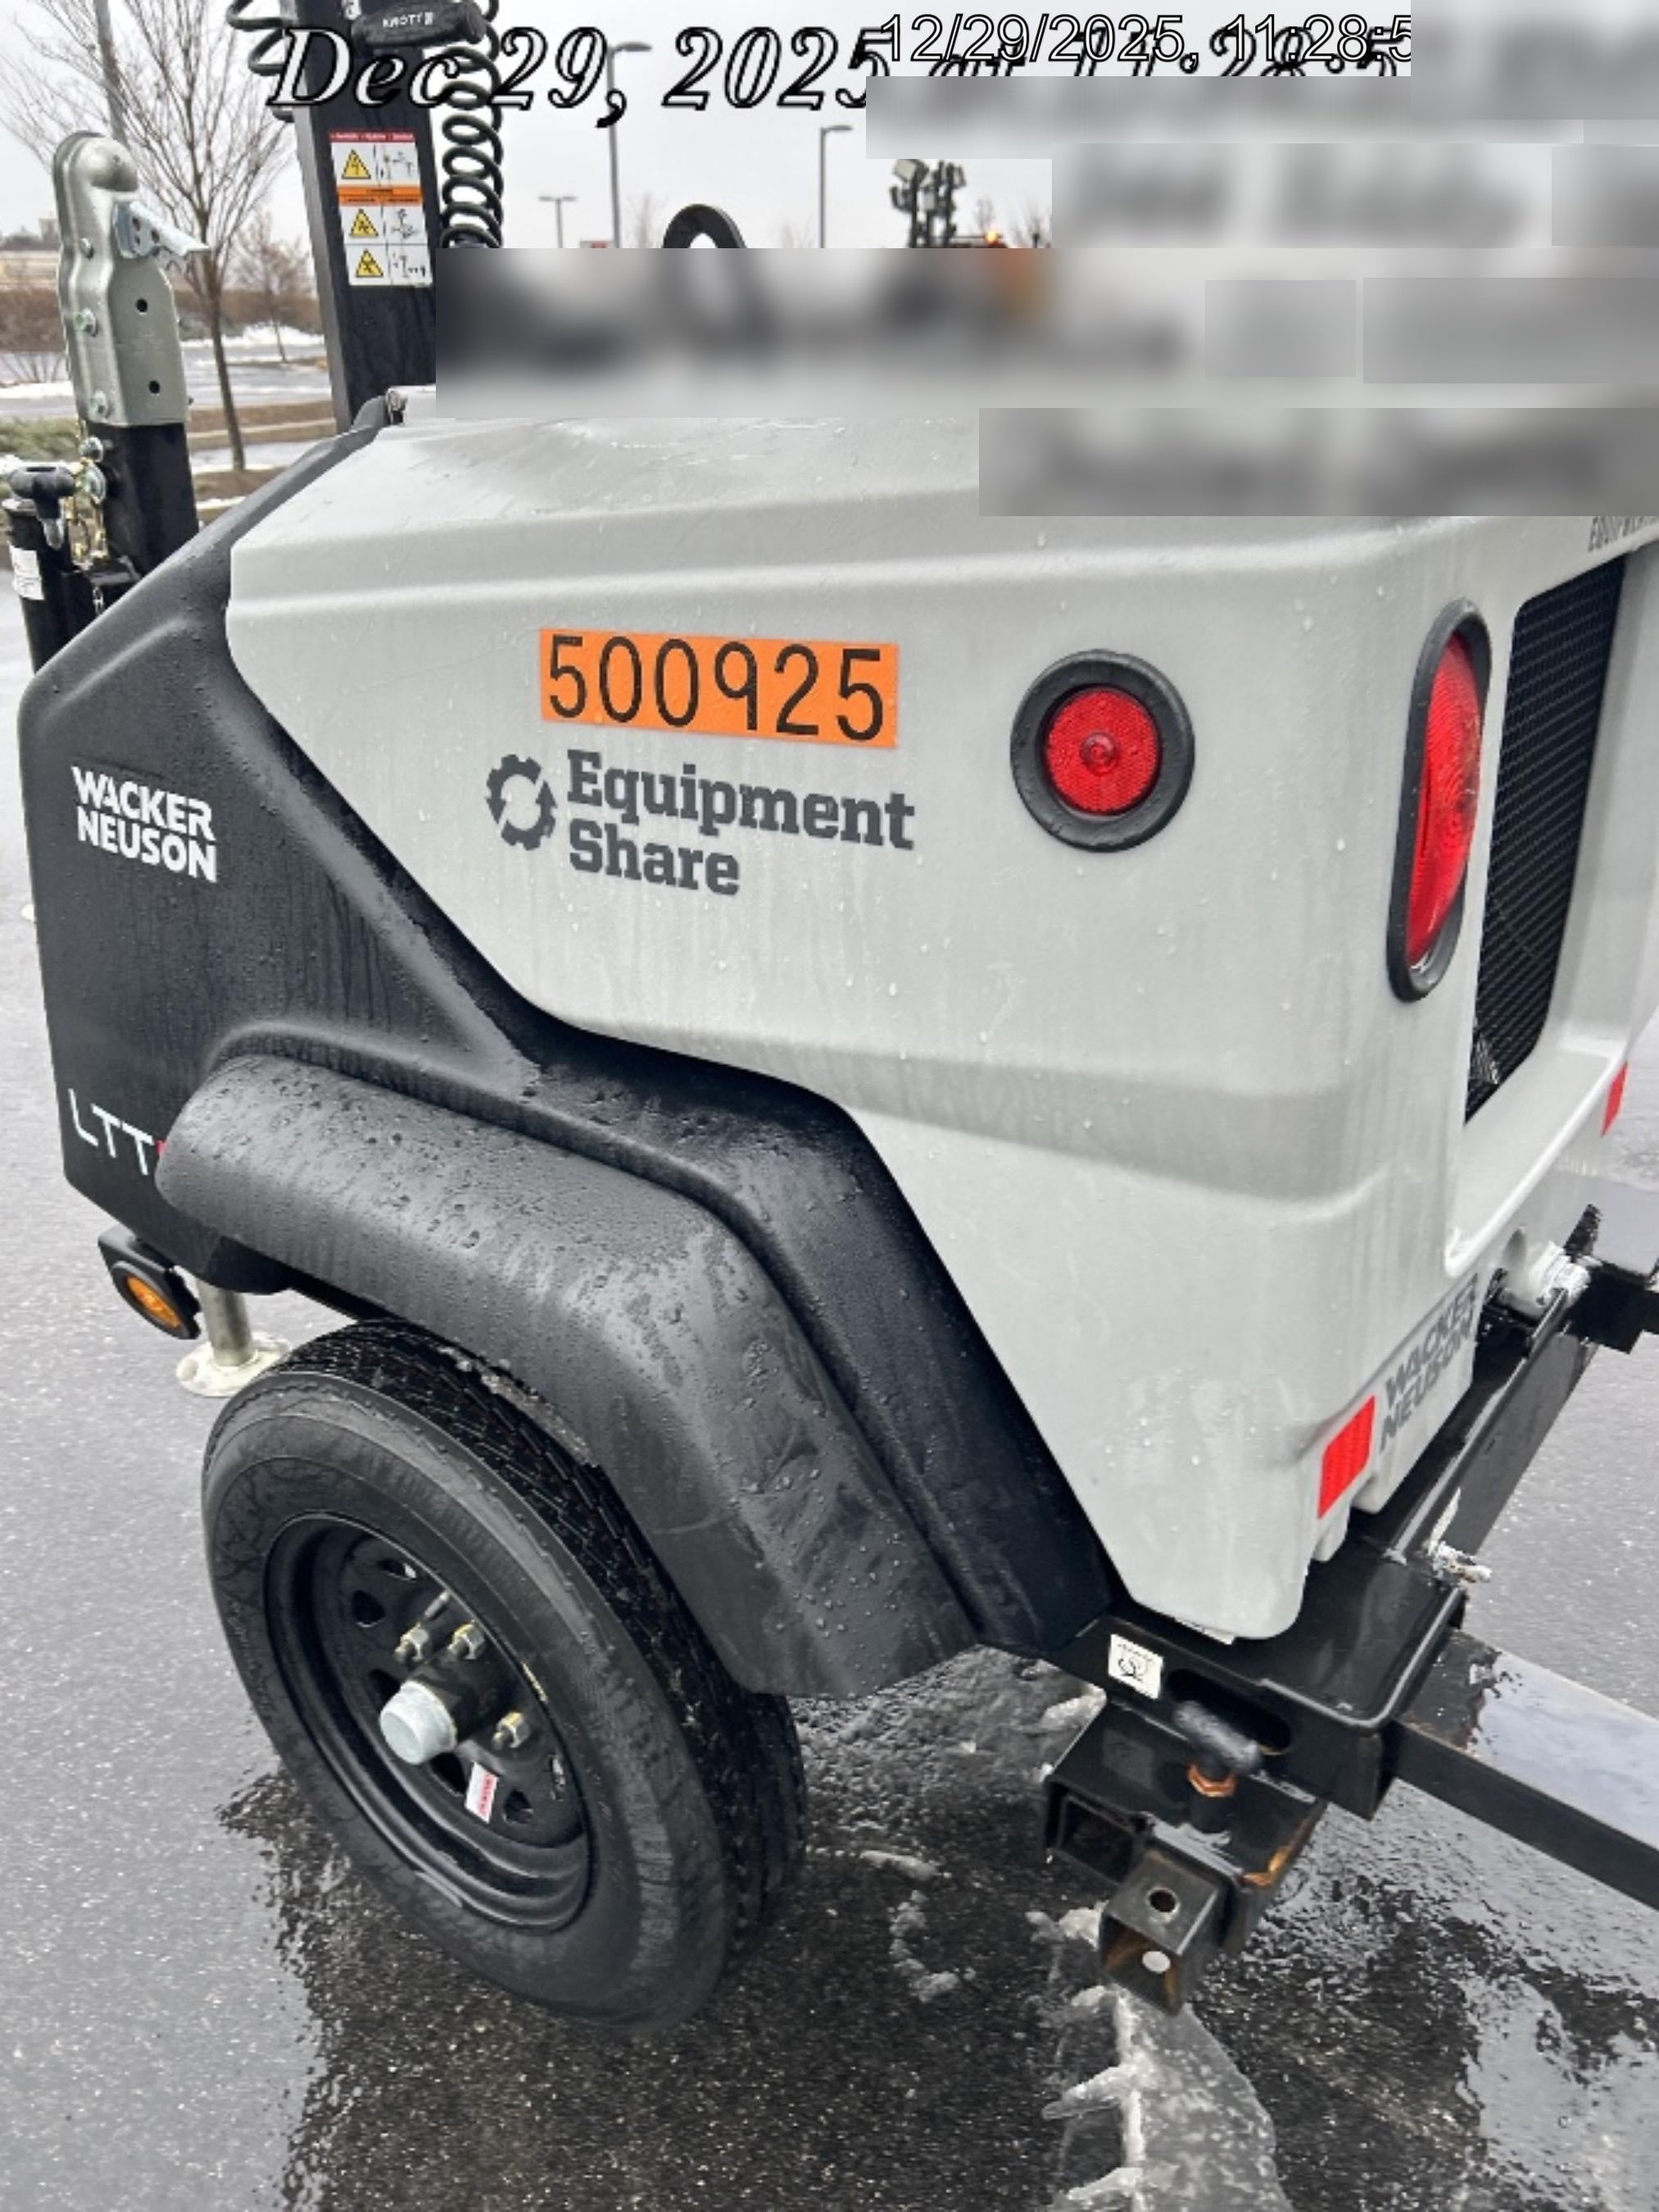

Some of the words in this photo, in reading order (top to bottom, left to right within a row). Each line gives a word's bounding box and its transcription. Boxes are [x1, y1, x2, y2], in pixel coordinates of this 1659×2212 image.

[550, 633, 884, 741] 500925
[70, 765, 216, 841] WACKER
[567, 748, 915, 851] Equipment
[77, 805, 217, 883] NEUSON
[569, 818, 741, 896] Share
[67, 1087, 168, 1176] LTT
